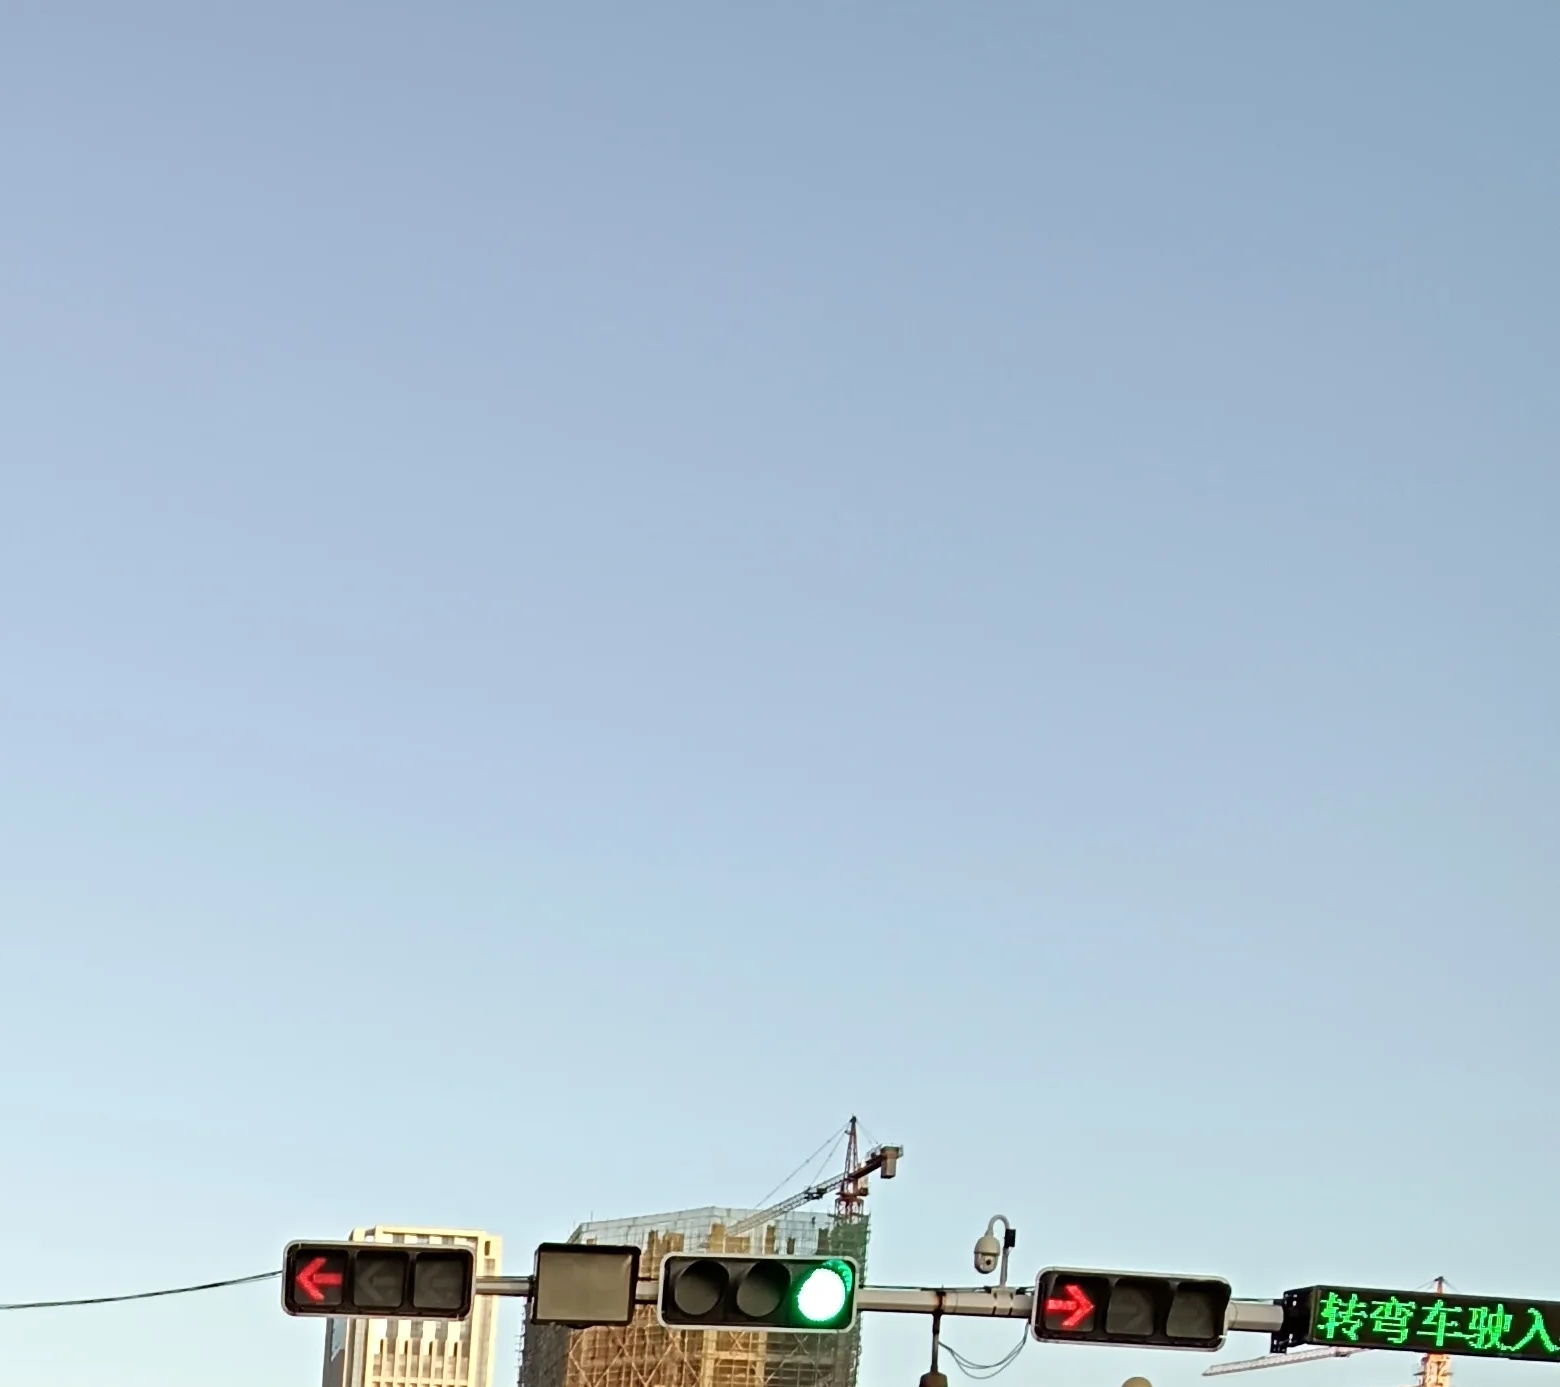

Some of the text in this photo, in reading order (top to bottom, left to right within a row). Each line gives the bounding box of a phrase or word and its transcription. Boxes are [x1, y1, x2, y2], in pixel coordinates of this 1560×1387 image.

[1317, 1291, 1559, 1352] 转弯车驶入
